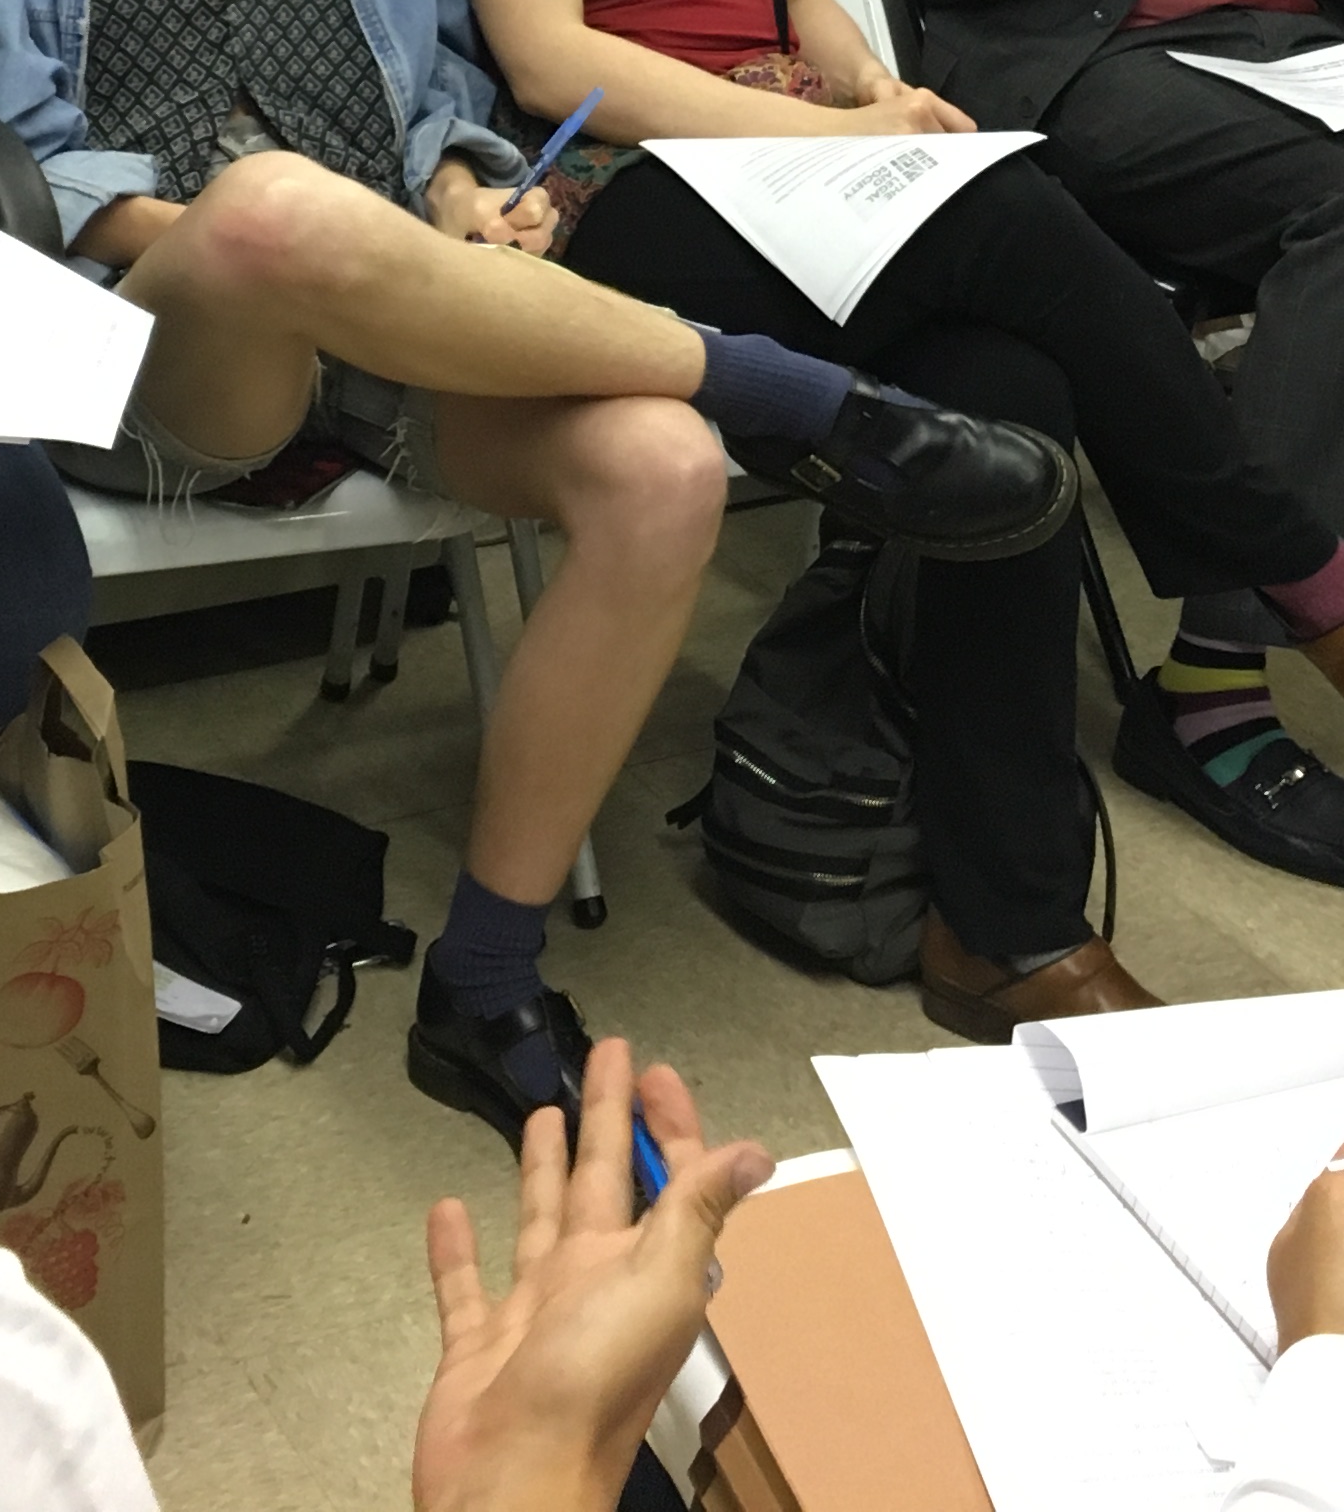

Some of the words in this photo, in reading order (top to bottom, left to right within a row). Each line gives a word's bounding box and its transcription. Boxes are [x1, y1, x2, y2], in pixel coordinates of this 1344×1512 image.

[844, 165, 888, 200] SOCIETY
[865, 176, 900, 202] LEGAL
[883, 182, 907, 201] THE
